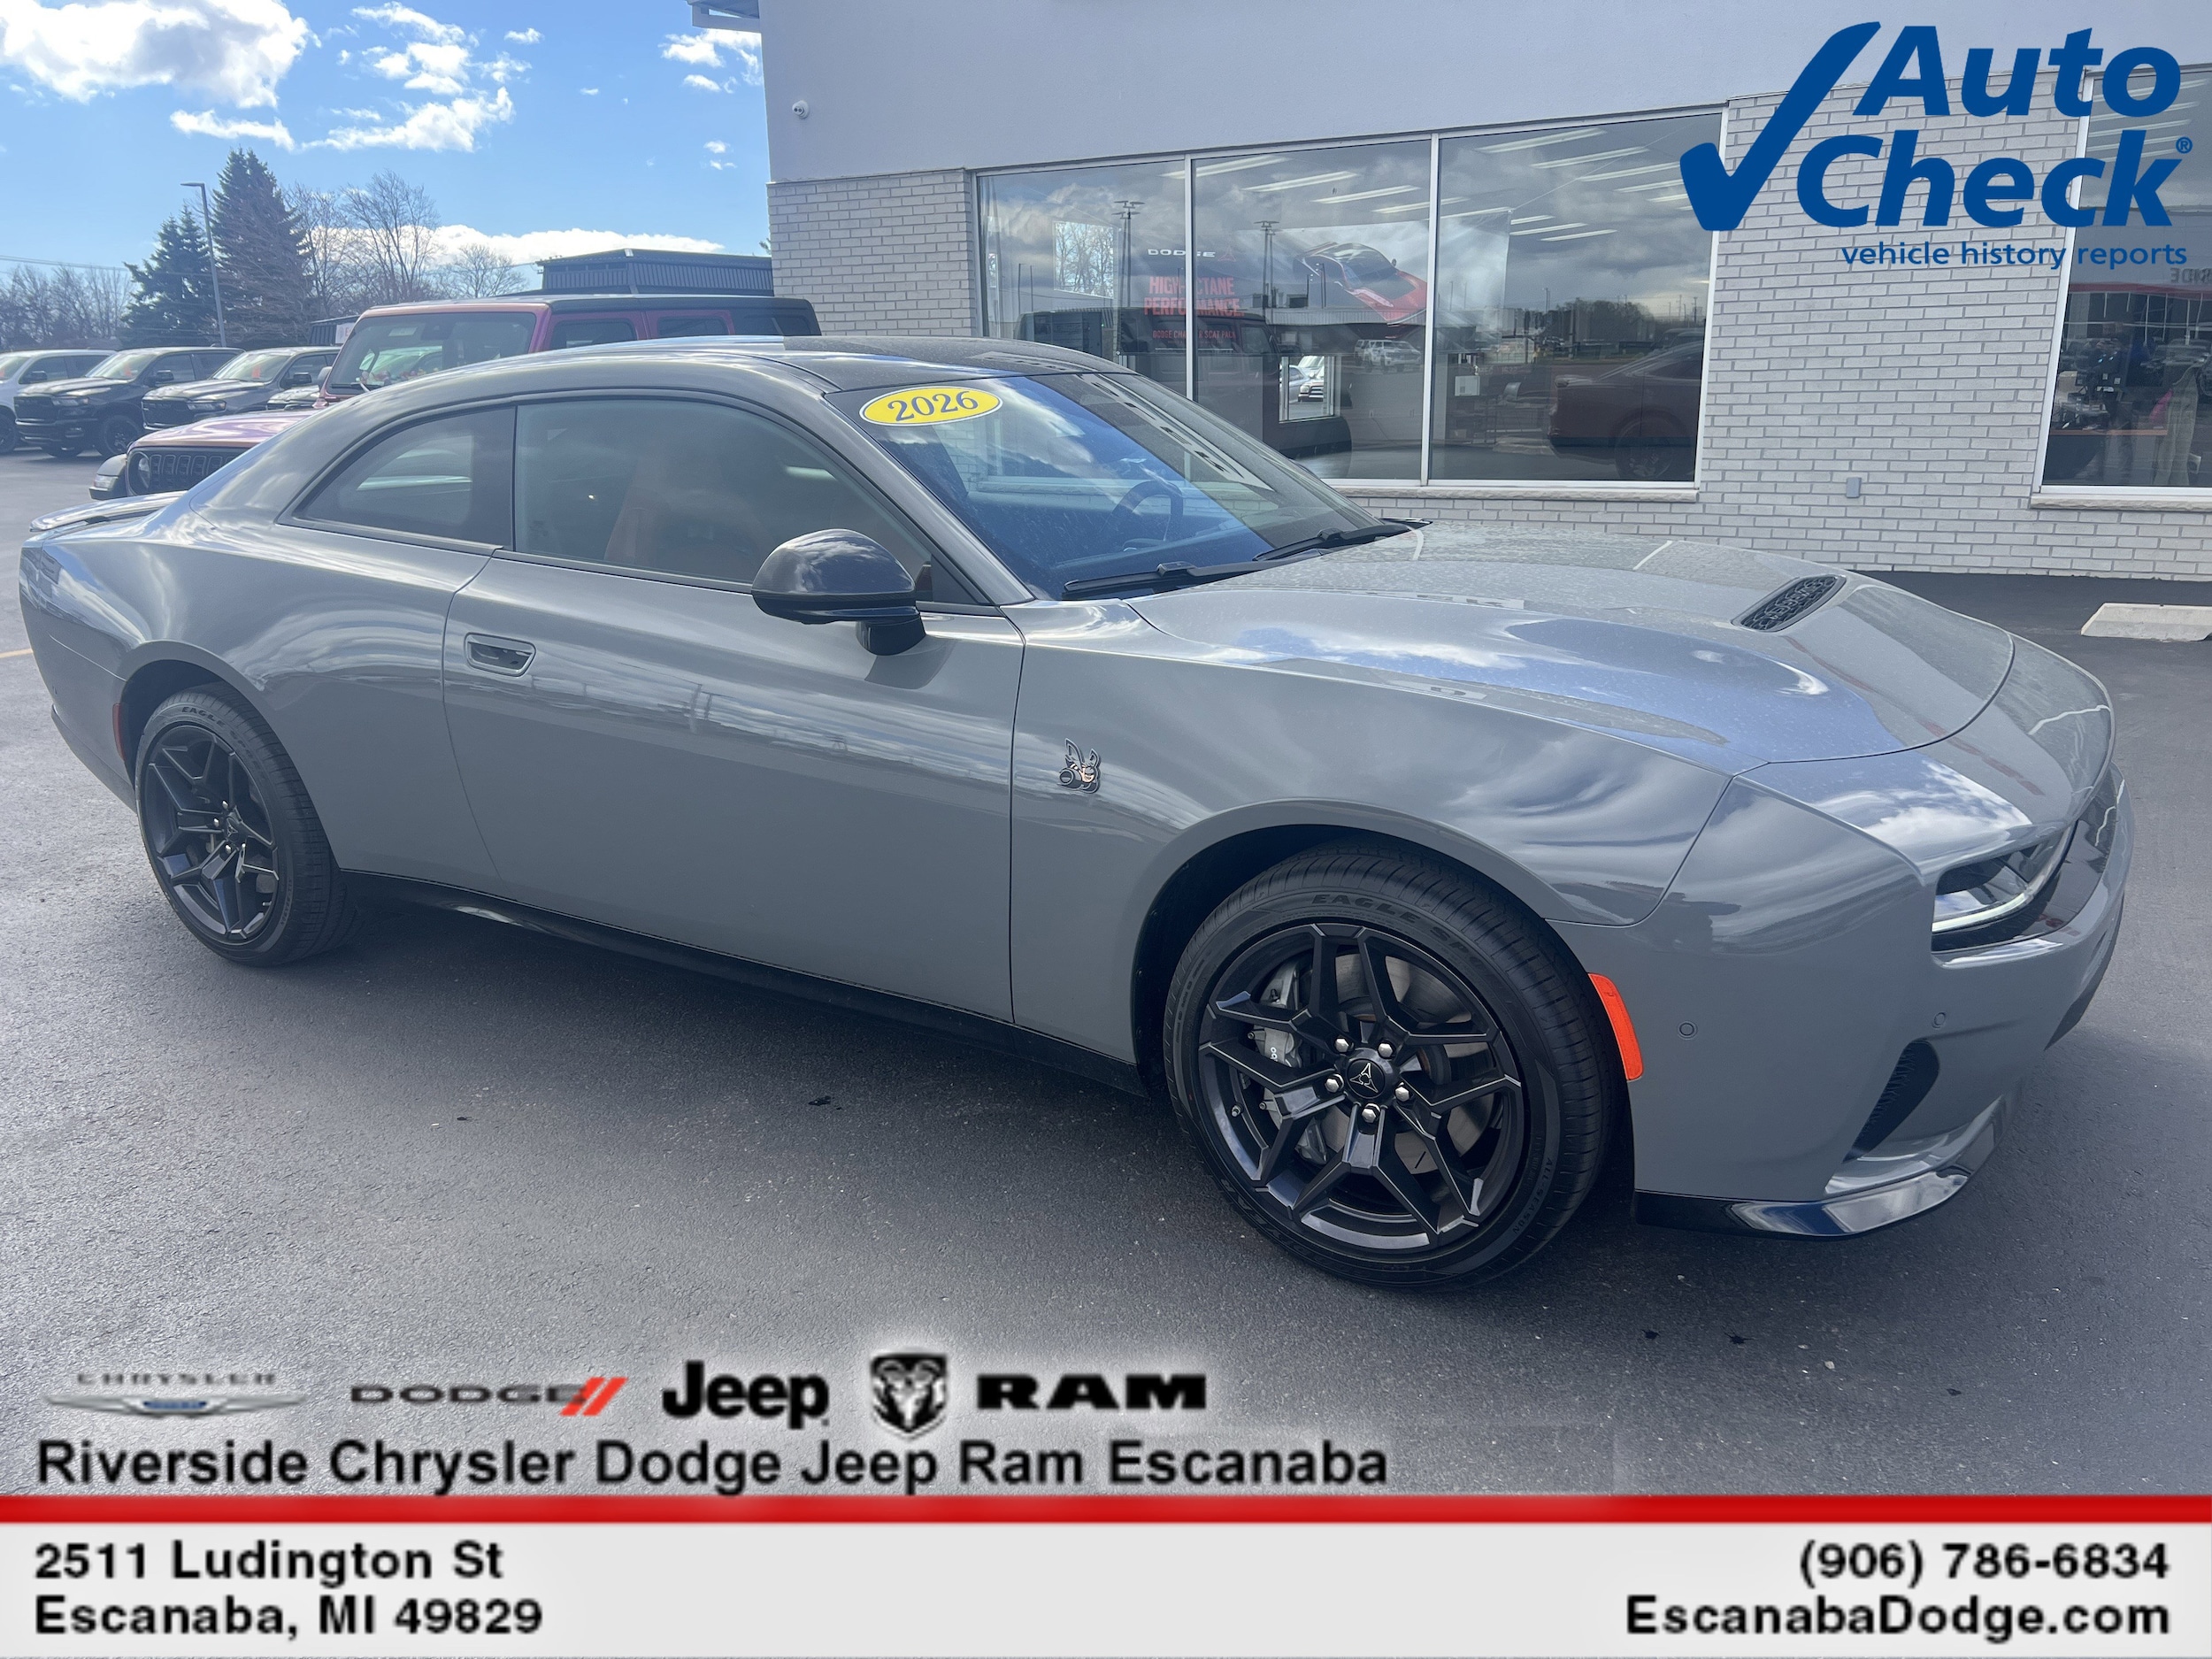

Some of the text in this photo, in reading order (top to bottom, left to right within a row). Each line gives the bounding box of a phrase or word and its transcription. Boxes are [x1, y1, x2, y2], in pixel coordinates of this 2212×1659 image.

[1148, 249, 1217, 257] DODE
[1149, 276, 1235, 296] HIGH-CTANE
[1144, 297, 1245, 317] PERFOMANCE.
[887, 389, 979, 422] 2026
[181, 706, 226, 726] EAGLE
[1312, 895, 1421, 924] EAGLE
